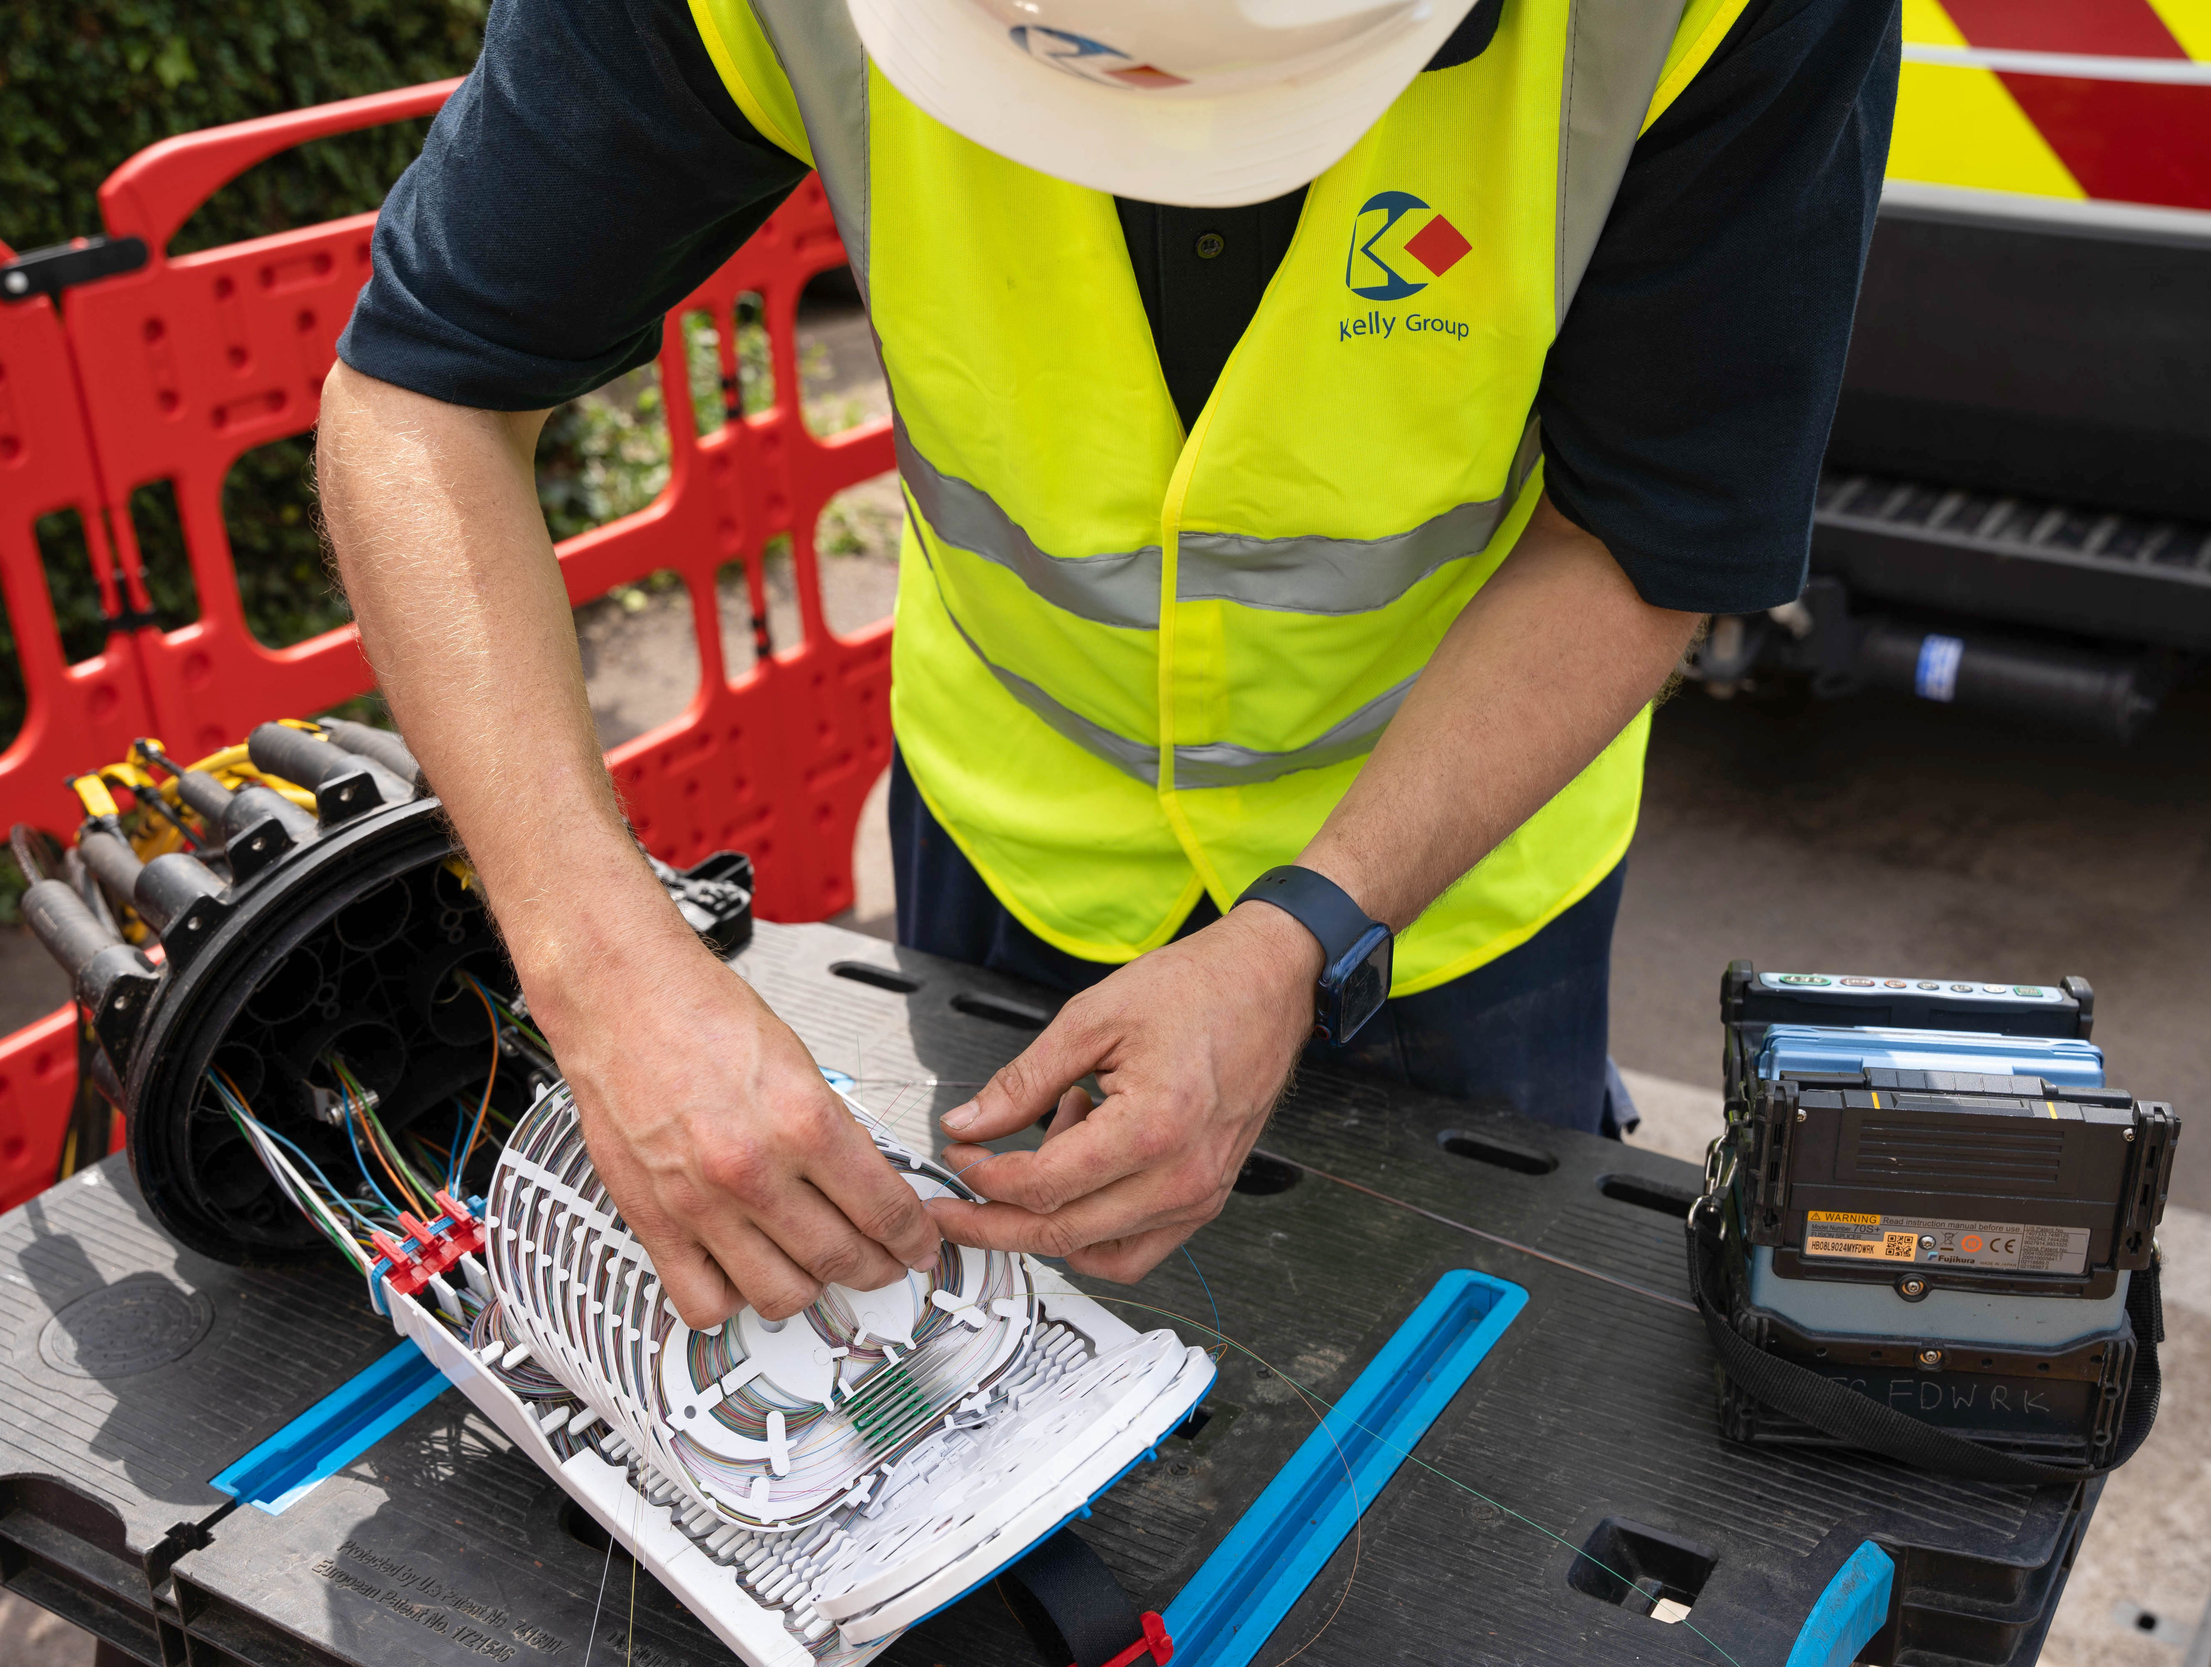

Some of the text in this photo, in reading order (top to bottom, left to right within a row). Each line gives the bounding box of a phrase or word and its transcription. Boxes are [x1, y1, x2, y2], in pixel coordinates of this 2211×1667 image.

[1339, 310, 1470, 342] Kelly Group
[1825, 1212, 1877, 1224] WARNING
[1882, 1216, 1904, 1225] Read
[1905, 1218, 1946, 1229] instruction
[1947, 1221, 1977, 1230] manual
[1978, 1222, 2004, 1232] before
[1810, 1231, 1862, 1240] FUSION SPLICER
[1853, 1224, 1881, 1234] 70S+
[1937, 1254, 1976, 1265] Fujikura
[336, 1540, 407, 1578] Protected
[397, 1566, 421, 1588] by
[440, 1587, 490, 1619] Patent
[311, 1558, 382, 1599] European
[377, 1590, 430, 1622] Patent
[450, 1625, 516, 1663] 1721546
